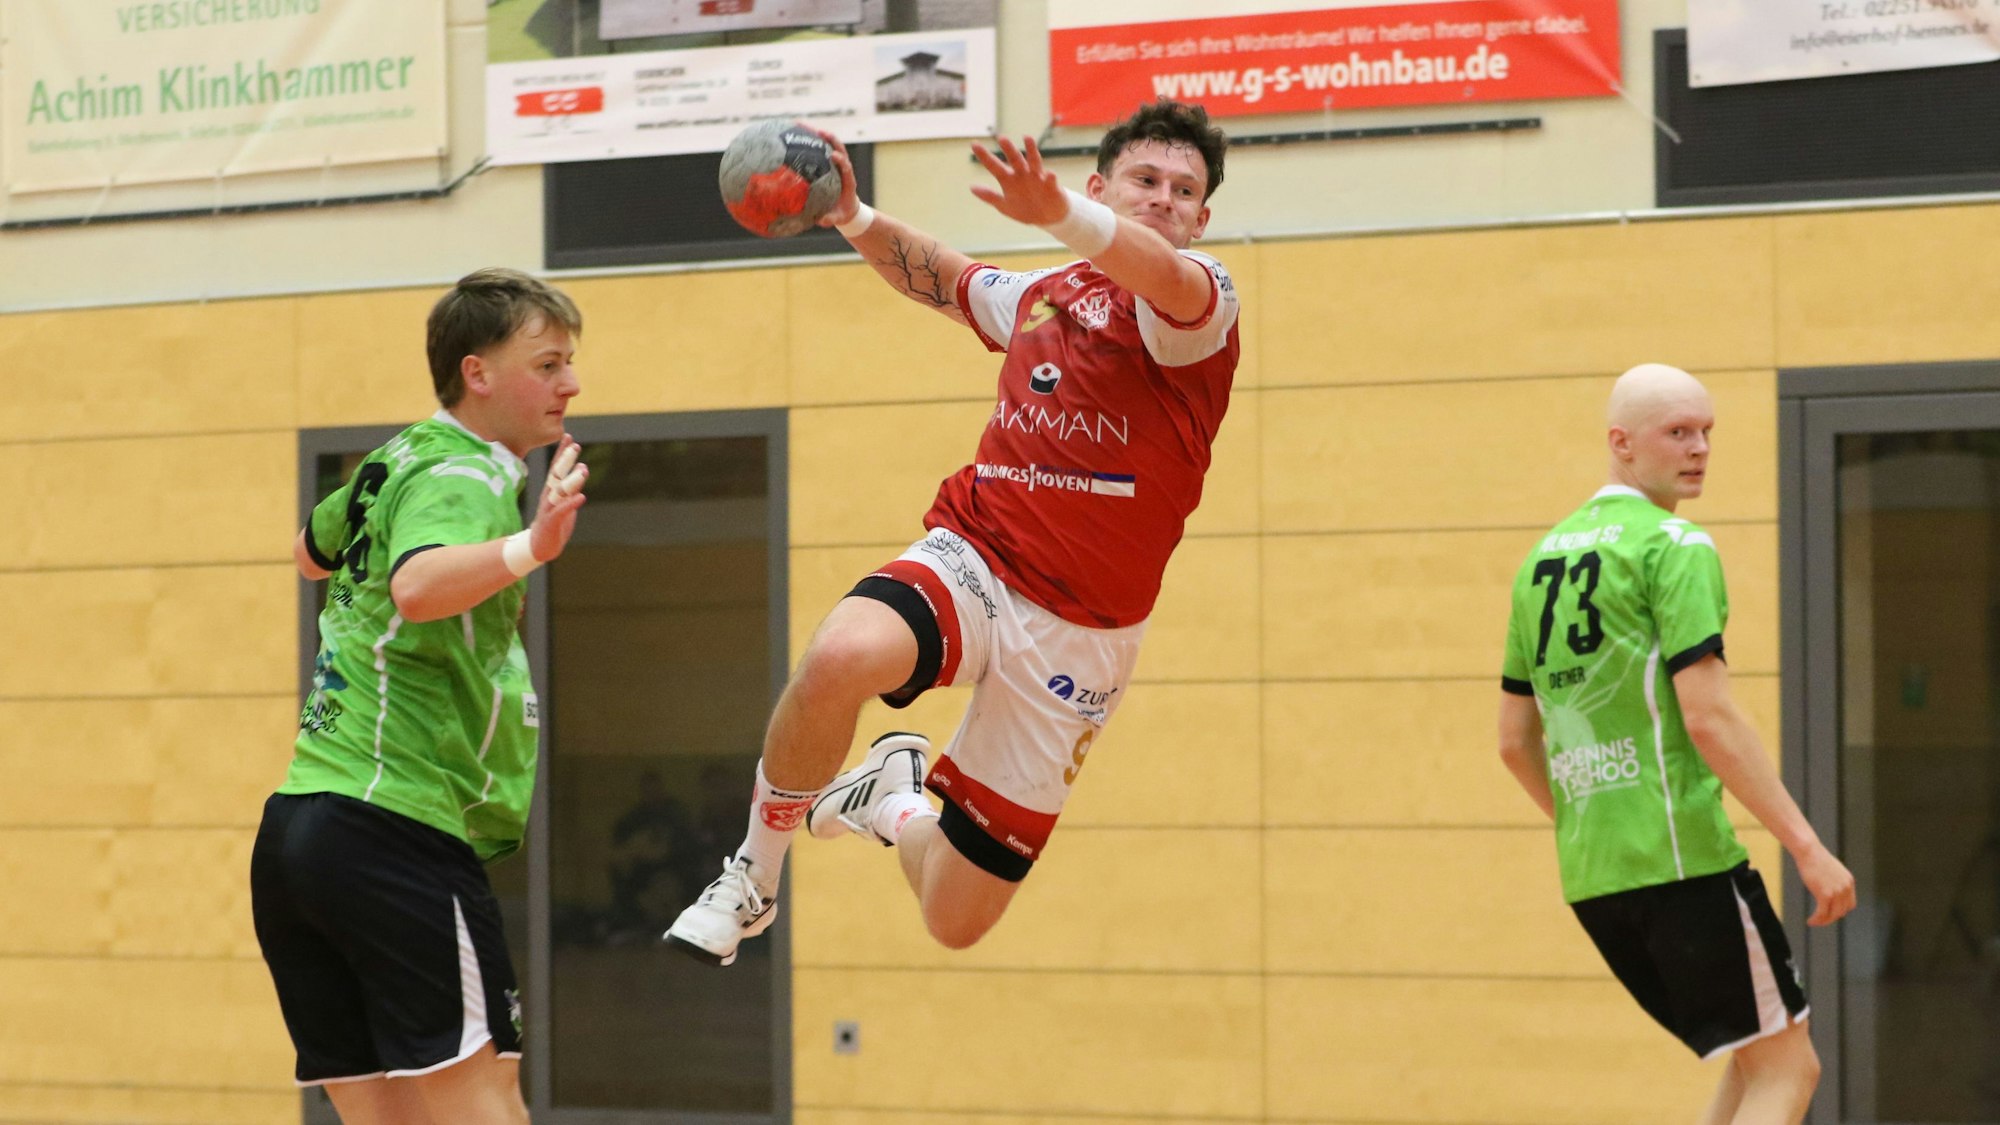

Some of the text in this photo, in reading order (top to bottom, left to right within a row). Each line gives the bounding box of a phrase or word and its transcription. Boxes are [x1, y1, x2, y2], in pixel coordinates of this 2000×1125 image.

[118, 0, 319, 33] VERSICHERUNG
[1076, 43, 1137, 64] Erfüllen
[1139, 41, 1164, 59] Sie
[1167, 37, 1198, 57] sich
[1348, 25, 1375, 44] Wir
[1378, 22, 1431, 43] helfen
[1434, 20, 1483, 40] Ihnen
[1486, 20, 1532, 41] gerne
[27, 56, 415, 126] Achim Klinkhammer
[1152, 44, 1509, 103] www.g-s-wohnbau.de
[1532, 550, 1604, 667] 73
[964, 798, 990, 827] Kempa
